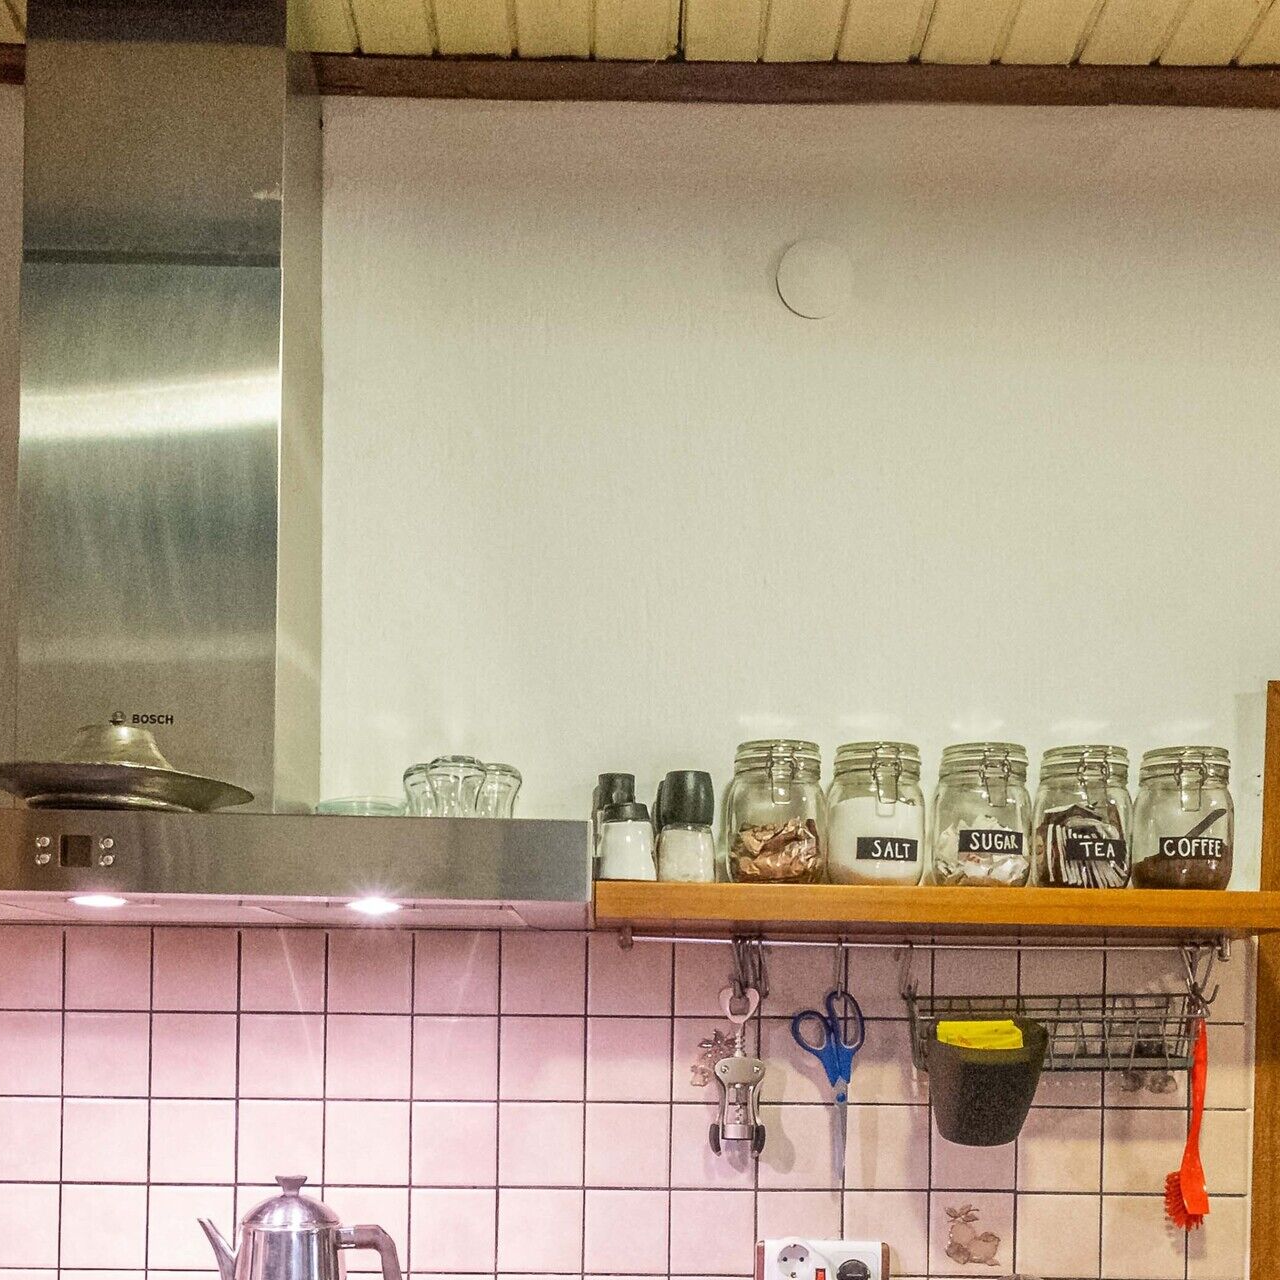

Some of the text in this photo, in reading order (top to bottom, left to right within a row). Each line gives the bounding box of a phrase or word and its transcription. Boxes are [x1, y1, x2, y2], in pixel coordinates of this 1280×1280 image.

[132, 714, 174, 725] BOSCH
[871, 840, 911, 858] SALT
[970, 832, 1019, 850] SUGAR
[1079, 841, 1116, 858] TEA
[1163, 838, 1222, 857] COFFEE
